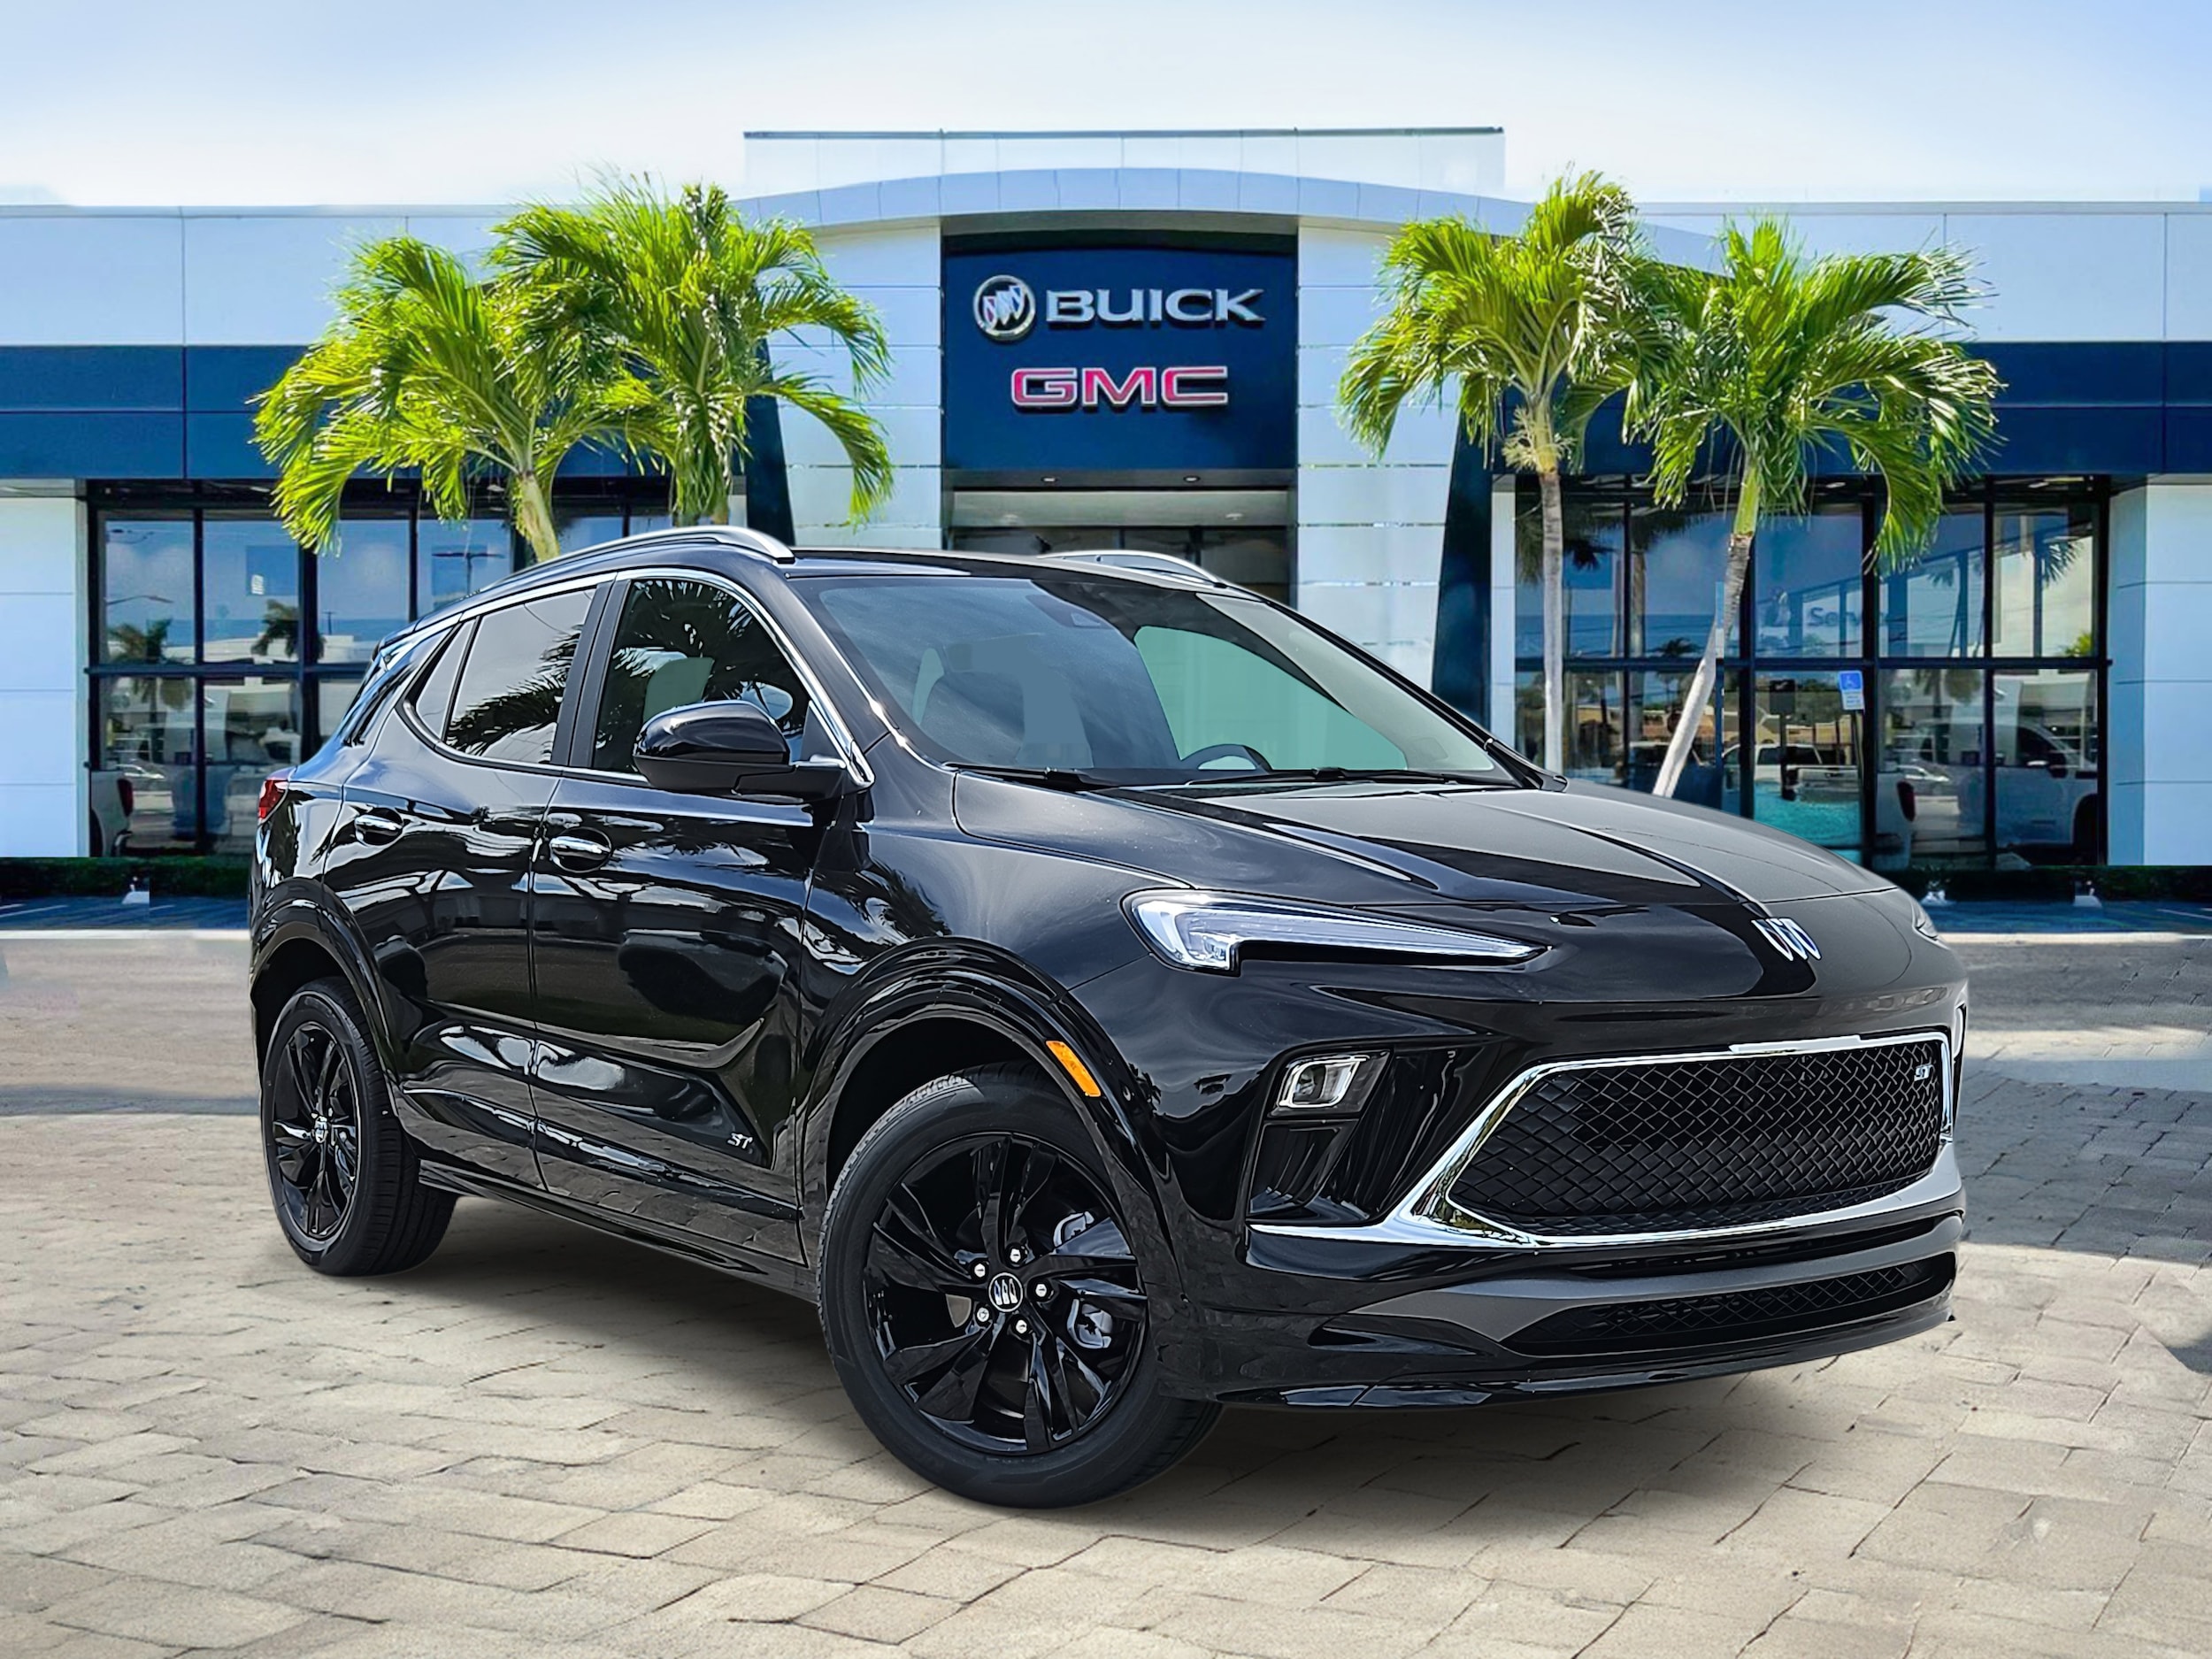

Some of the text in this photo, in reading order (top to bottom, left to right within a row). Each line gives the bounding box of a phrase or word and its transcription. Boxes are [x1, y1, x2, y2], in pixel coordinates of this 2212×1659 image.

[1046, 288, 1265, 322] BUICK
[1011, 365, 1228, 406] GMC
[1914, 1064, 1936, 1081] ST
[727, 1133, 753, 1149] ST
